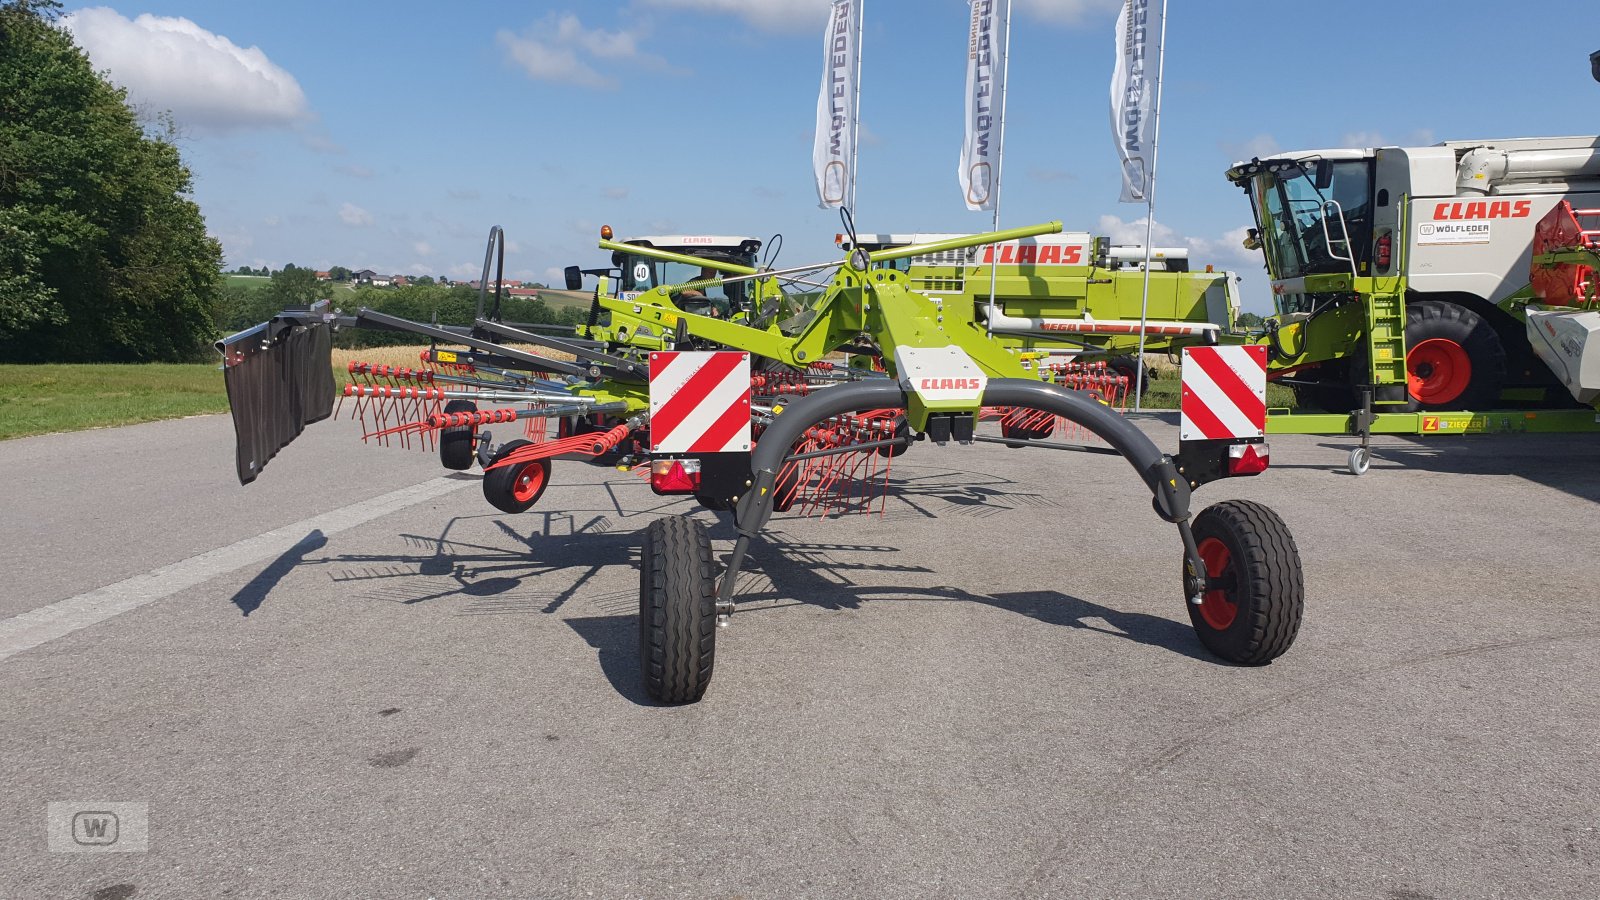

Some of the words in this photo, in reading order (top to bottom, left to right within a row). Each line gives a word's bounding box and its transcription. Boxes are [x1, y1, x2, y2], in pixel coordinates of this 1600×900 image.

[1433, 200, 1532, 220] CLAAS
[1436, 224, 1489, 232] WÖLFLEDER
[983, 244, 1082, 264] CLAAS
[636, 267, 647, 279] 40
[1040, 323, 1076, 331] MEGA
[921, 378, 980, 390] CLAAS
[1425, 417, 1437, 430] Z
